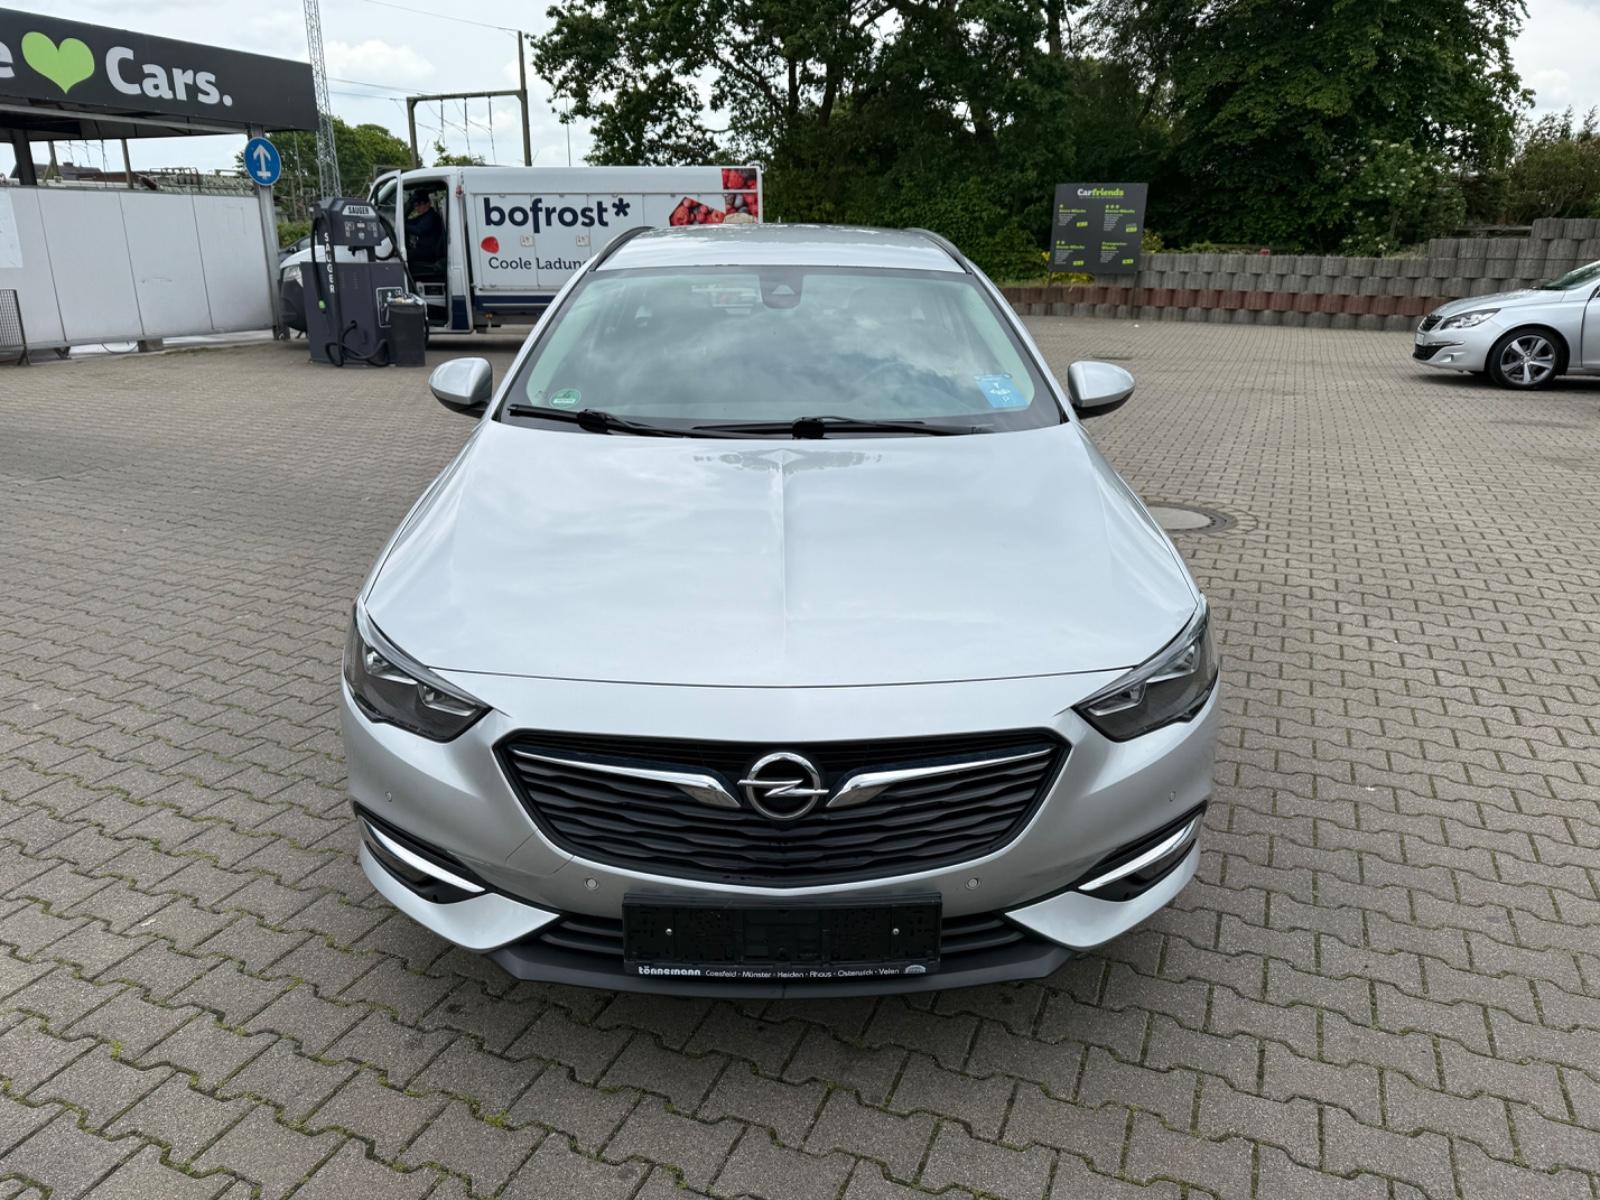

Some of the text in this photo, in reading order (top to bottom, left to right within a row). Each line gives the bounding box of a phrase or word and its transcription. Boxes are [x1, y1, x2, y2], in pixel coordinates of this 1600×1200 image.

[105, 46, 233, 107] Cars.
[1077, 188, 1125, 197] Carfriends
[324, 232, 335, 294] SAUGER
[488, 257, 587, 270] Coole Ladun
[638, 965, 701, 976] tönnemann
[742, 970, 772, 978] Münster
